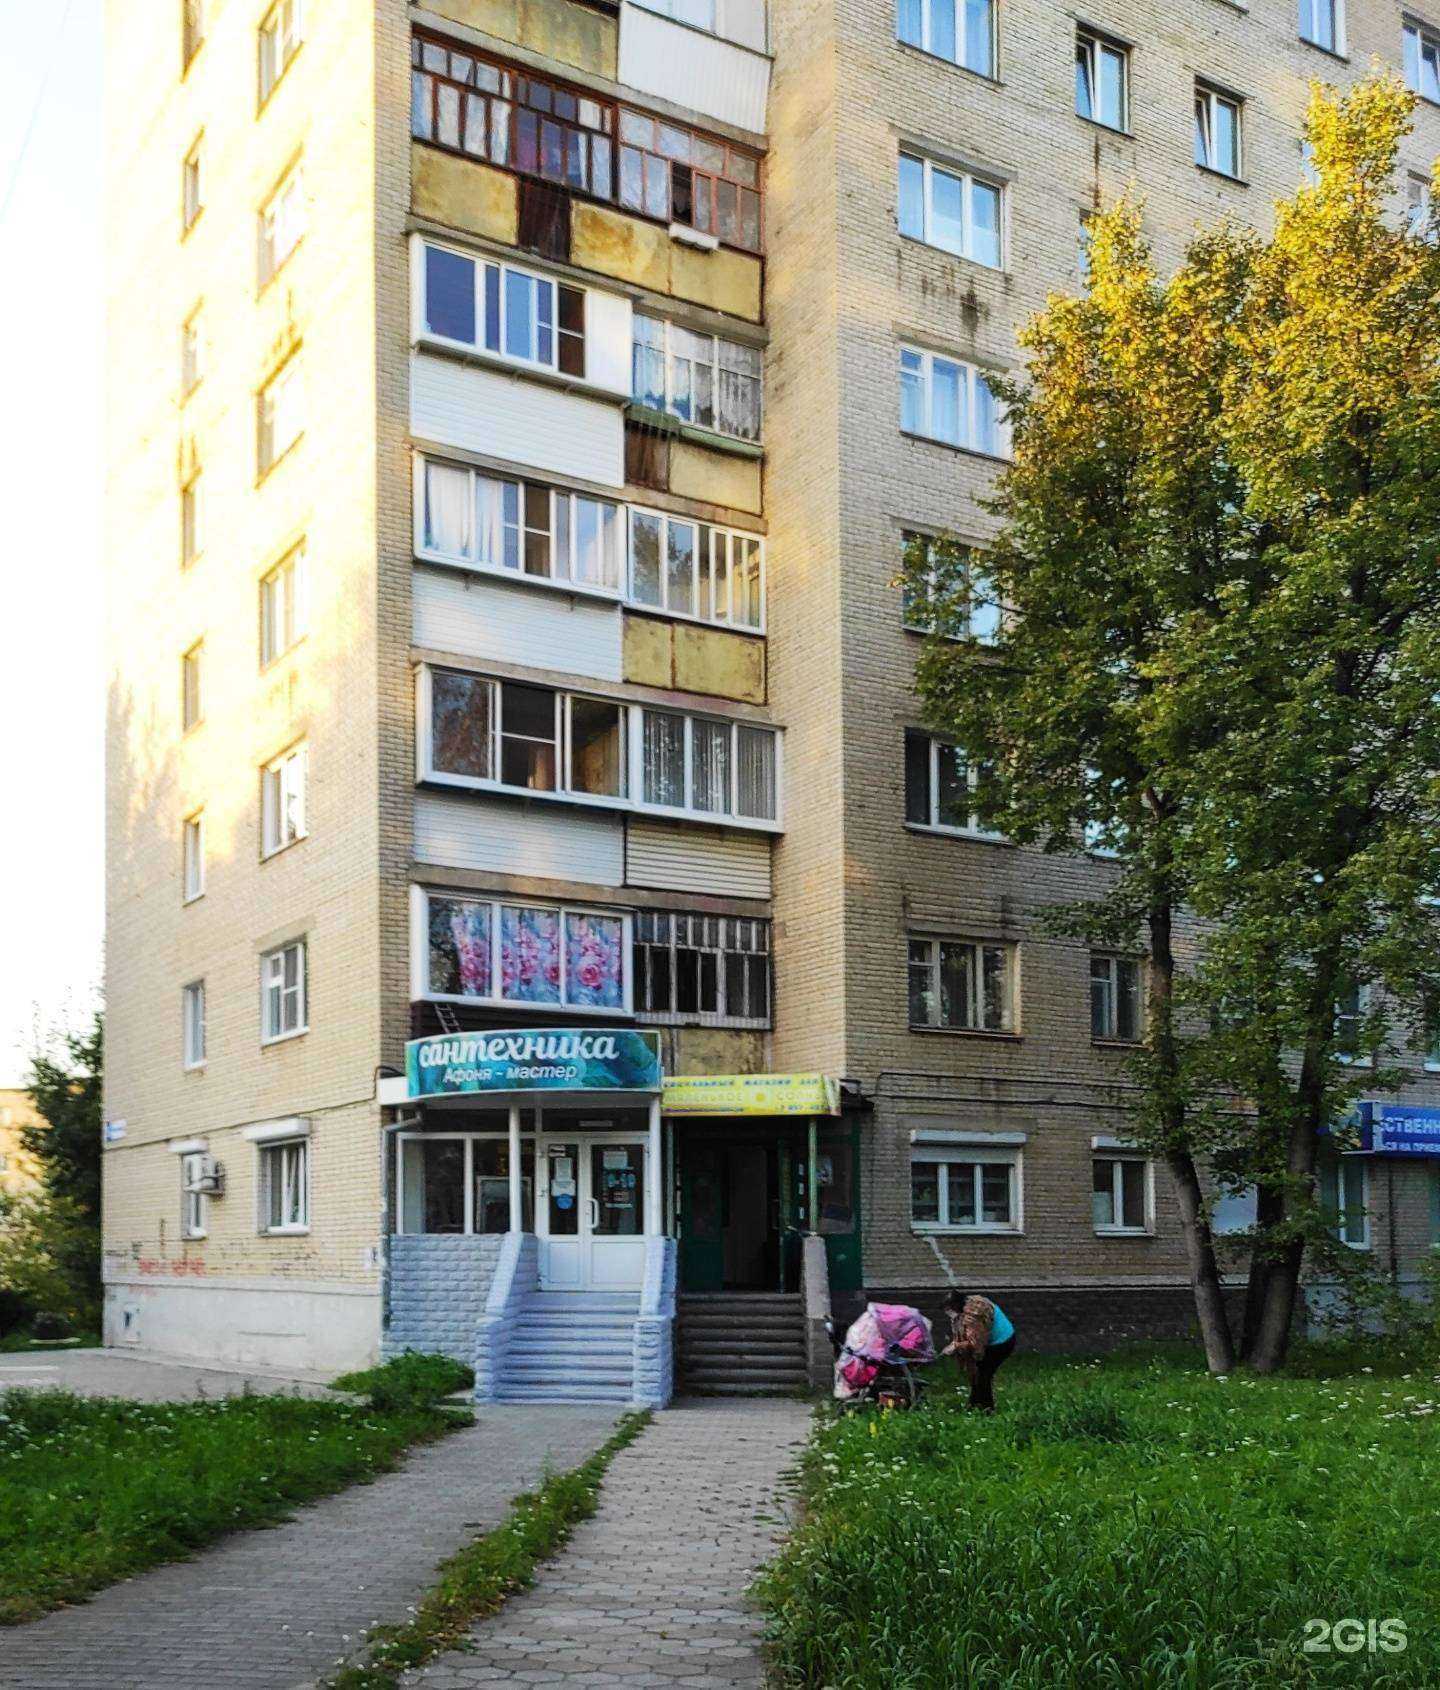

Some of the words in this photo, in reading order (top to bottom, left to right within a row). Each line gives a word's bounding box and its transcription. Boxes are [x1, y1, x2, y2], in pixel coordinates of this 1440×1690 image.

[418, 1035, 620, 1068] сантехника
[443, 1066, 492, 1085] Афоня
[506, 1064, 577, 1082] мастер
